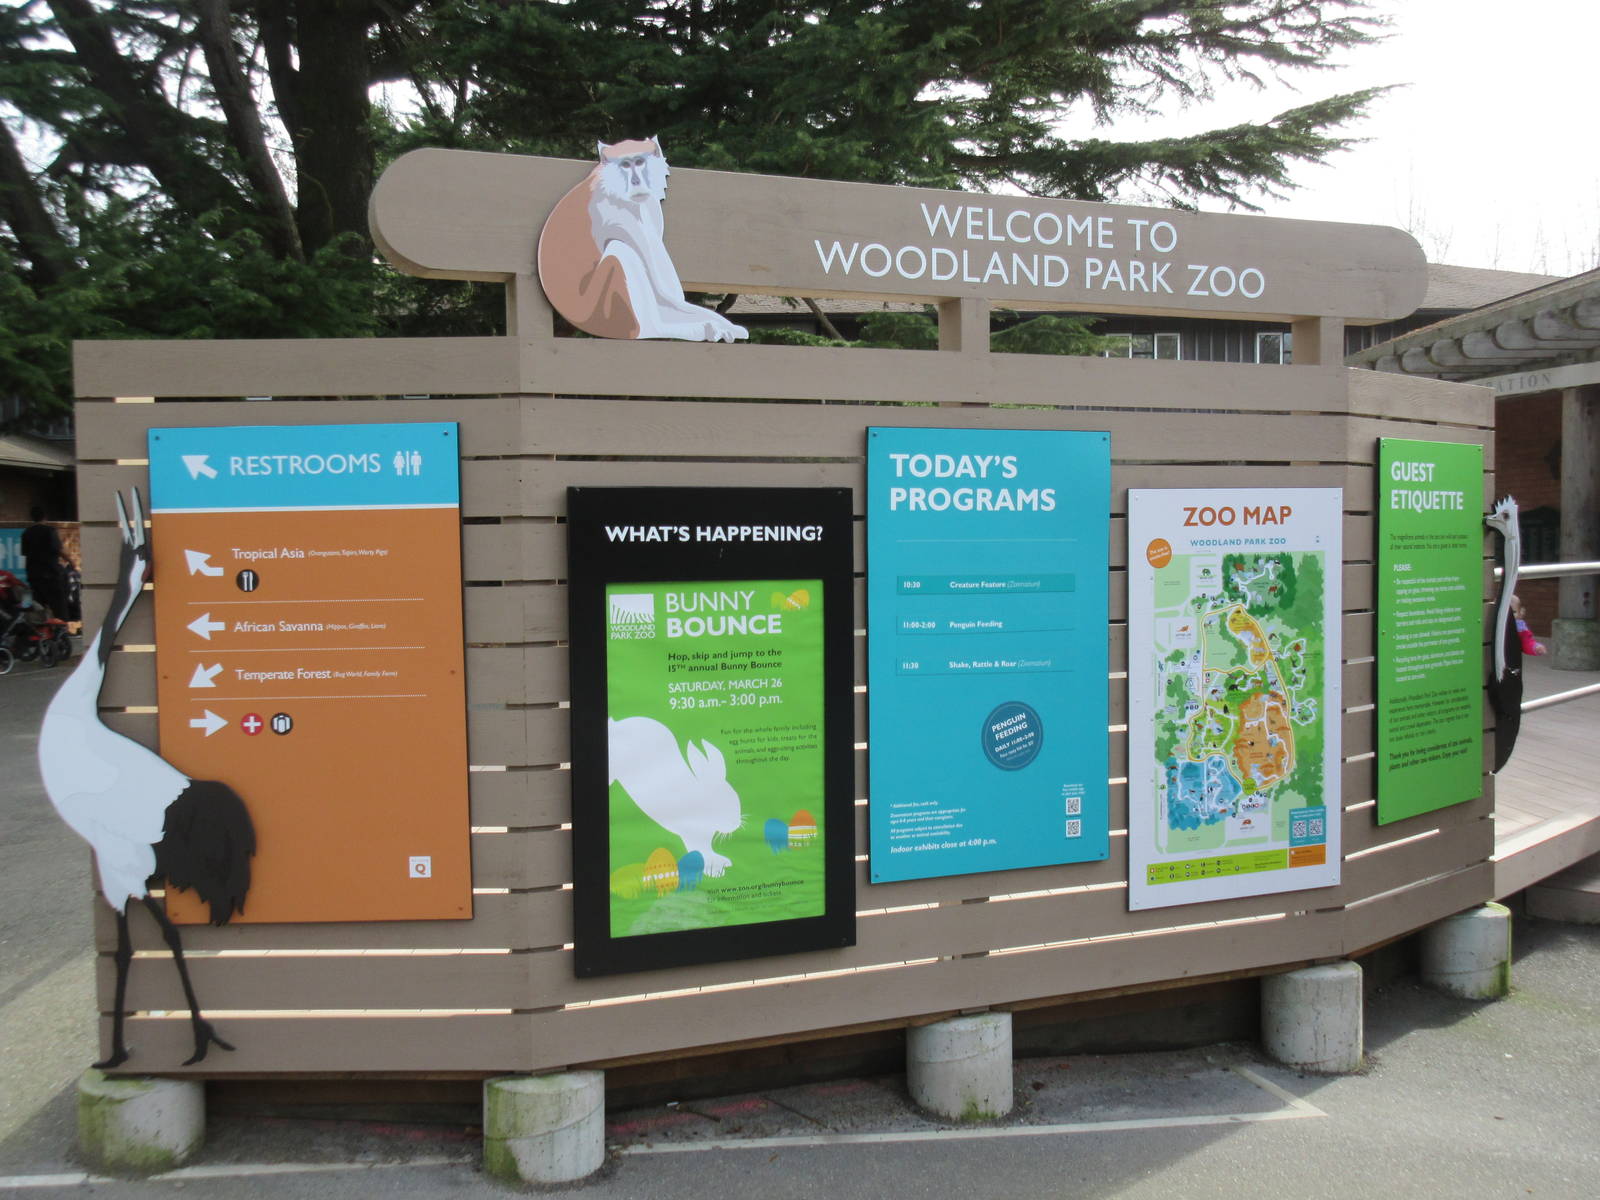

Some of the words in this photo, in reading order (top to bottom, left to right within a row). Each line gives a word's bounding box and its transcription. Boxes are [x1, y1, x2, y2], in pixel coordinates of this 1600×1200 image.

[921, 203, 1113, 249] WELCOME
[1127, 218, 1178, 253] TO
[814, 239, 1069, 287] WOODLAND
[1085, 257, 1172, 294] PARK
[1187, 264, 1266, 298] ZOO
[230, 453, 381, 477] RESTROOMS
[889, 453, 1018, 479] TODAY'S
[1391, 461, 1435, 482] GUEST
[890, 487, 1056, 512] PROGRAMS
[1391, 489, 1464, 513] ETIQUETTE
[1183, 506, 1236, 527] ZOO
[1243, 505, 1293, 526] MAP
[605, 526, 690, 542] WHAT'S
[696, 525, 823, 542] HAPPENING?
[1190, 538, 1242, 547] WOODLAND
[1244, 537, 1266, 545] PARK
[1269, 537, 1286, 545] ZOO
[231, 548, 277, 562] Tropical
[280, 548, 304, 559] Asia
[950, 580, 980, 589] Creature
[980, 580, 1006, 589] Feature
[665, 591, 755, 613] BUNNY
[233, 621, 275, 632] African
[279, 620, 323, 632] Savanna
[610, 624, 656, 632] WOODLAND
[666, 614, 782, 638] BOUNCE
[949, 621, 975, 631] Penguin
[977, 620, 1003, 629] Feeding
[610, 631, 632, 640] PARK
[635, 631, 656, 639] ZOO
[668, 653, 690, 662] Hop,
[692, 651, 710, 661] skip
[712, 650, 728, 659] and
[730, 650, 753, 661] jump
[755, 650, 765, 658] to
[767, 649, 782, 657] the
[668, 664, 686, 673] 15TH
[688, 662, 718, 671] annual
[720, 661, 748, 672] Bunny
[750, 660, 782, 669] Bounce
[949, 661, 971, 670] Shake,
[973, 660, 993, 669] Rattle
[994, 660, 999, 668] &
[1001, 660, 1016, 668] Roar
[234, 668, 294, 683] Temperate
[297, 667, 332, 680] Forest
[668, 680, 726, 694] SATURDAY,
[728, 679, 768, 690] MARCH
[770, 678, 782, 688] 26
[669, 697, 695, 710] 9:30
[730, 693, 756, 706] 3:00
[759, 693, 783, 708] p.m.
[991, 712, 1026, 733] PENGUIN
[995, 721, 1028, 741] FEEDING
[994, 742, 1010, 753] DAILY
[890, 846, 913, 854] Indoor
[914, 843, 940, 852] exhibits
[941, 841, 957, 850] close
[967, 838, 982, 847] 4:00
[983, 839, 997, 848] p.m.
[415, 863, 426, 876] Q
